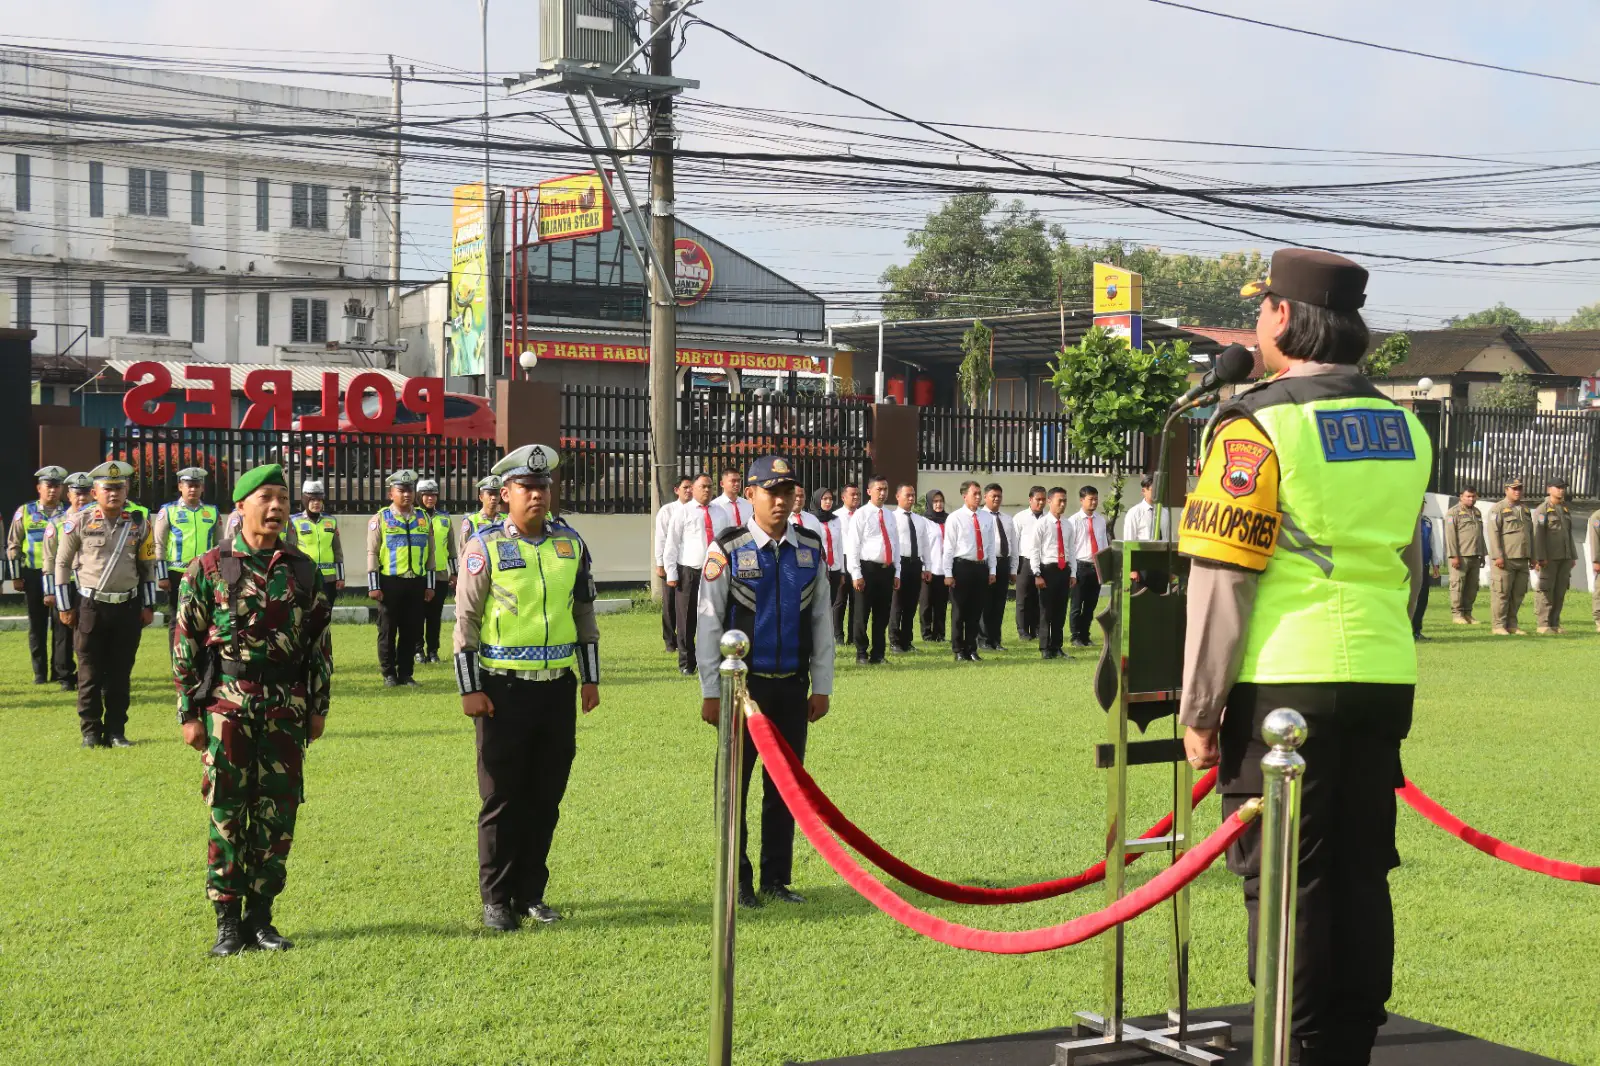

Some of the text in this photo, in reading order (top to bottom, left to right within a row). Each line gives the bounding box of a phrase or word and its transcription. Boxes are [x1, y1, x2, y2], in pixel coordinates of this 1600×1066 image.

[540, 211, 600, 235] RAJANYA STEAK
[506, 341, 548, 357] TIAP
[554, 344, 596, 359] HARI
[603, 346, 648, 361] RABU
[729, 353, 787, 369] DISKON
[1321, 416, 1409, 453] POLISI
